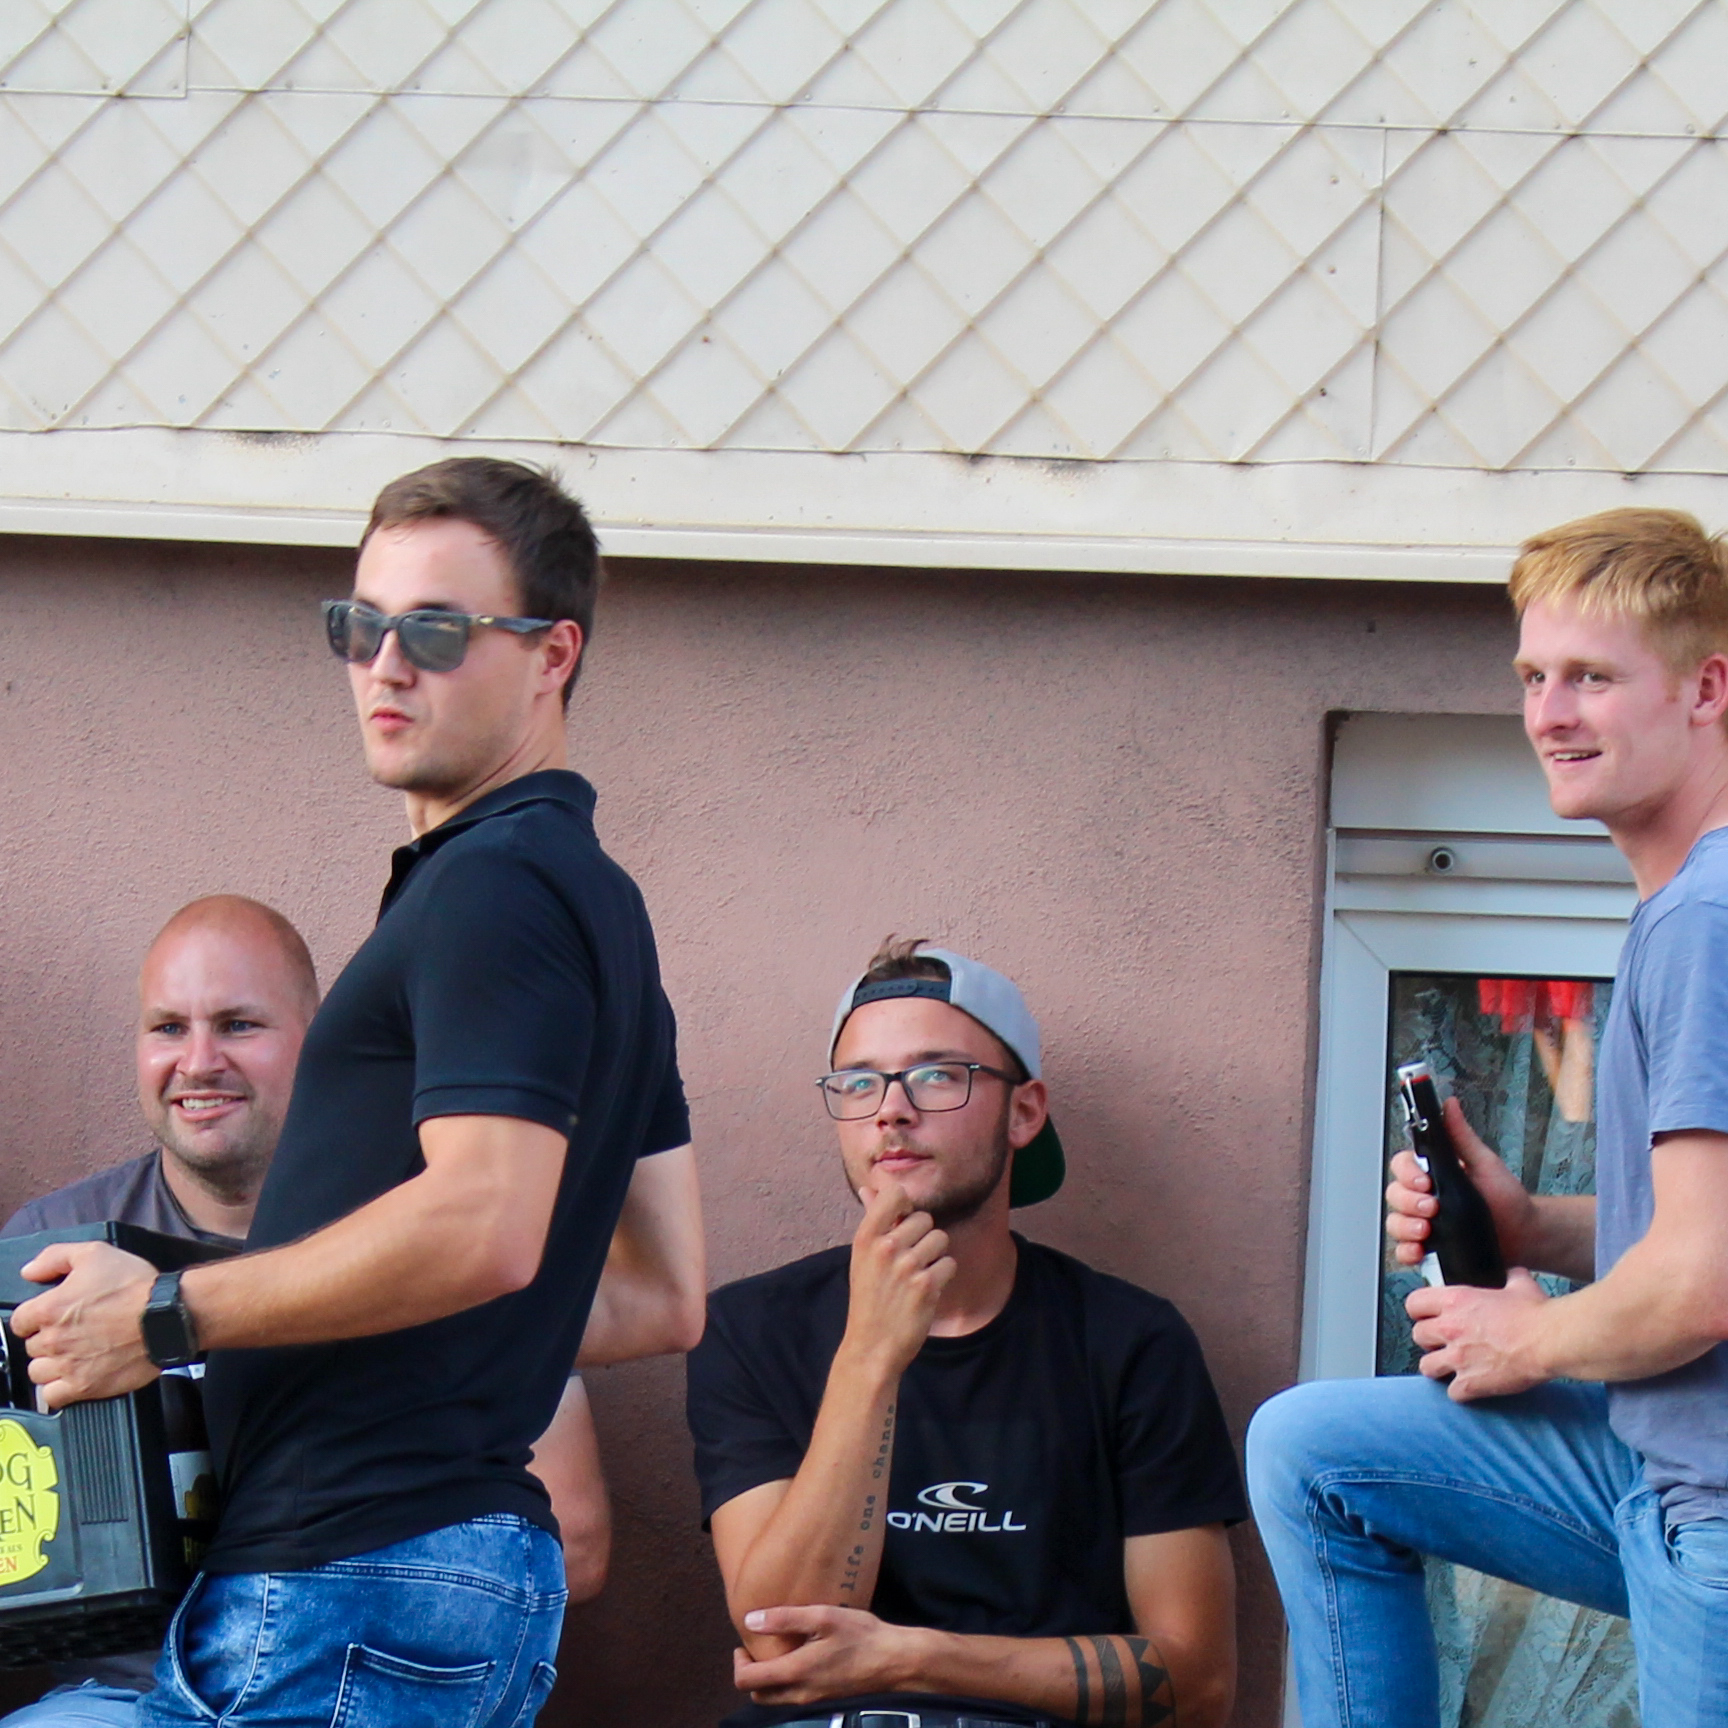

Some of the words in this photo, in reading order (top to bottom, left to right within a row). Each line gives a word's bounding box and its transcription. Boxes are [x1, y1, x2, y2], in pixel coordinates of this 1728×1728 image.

[840, 1545, 864, 1592] life
[860, 1494, 876, 1531] one
[870, 1404, 895, 1480] chance
[886, 1510, 1027, 1533] O'NEILL
